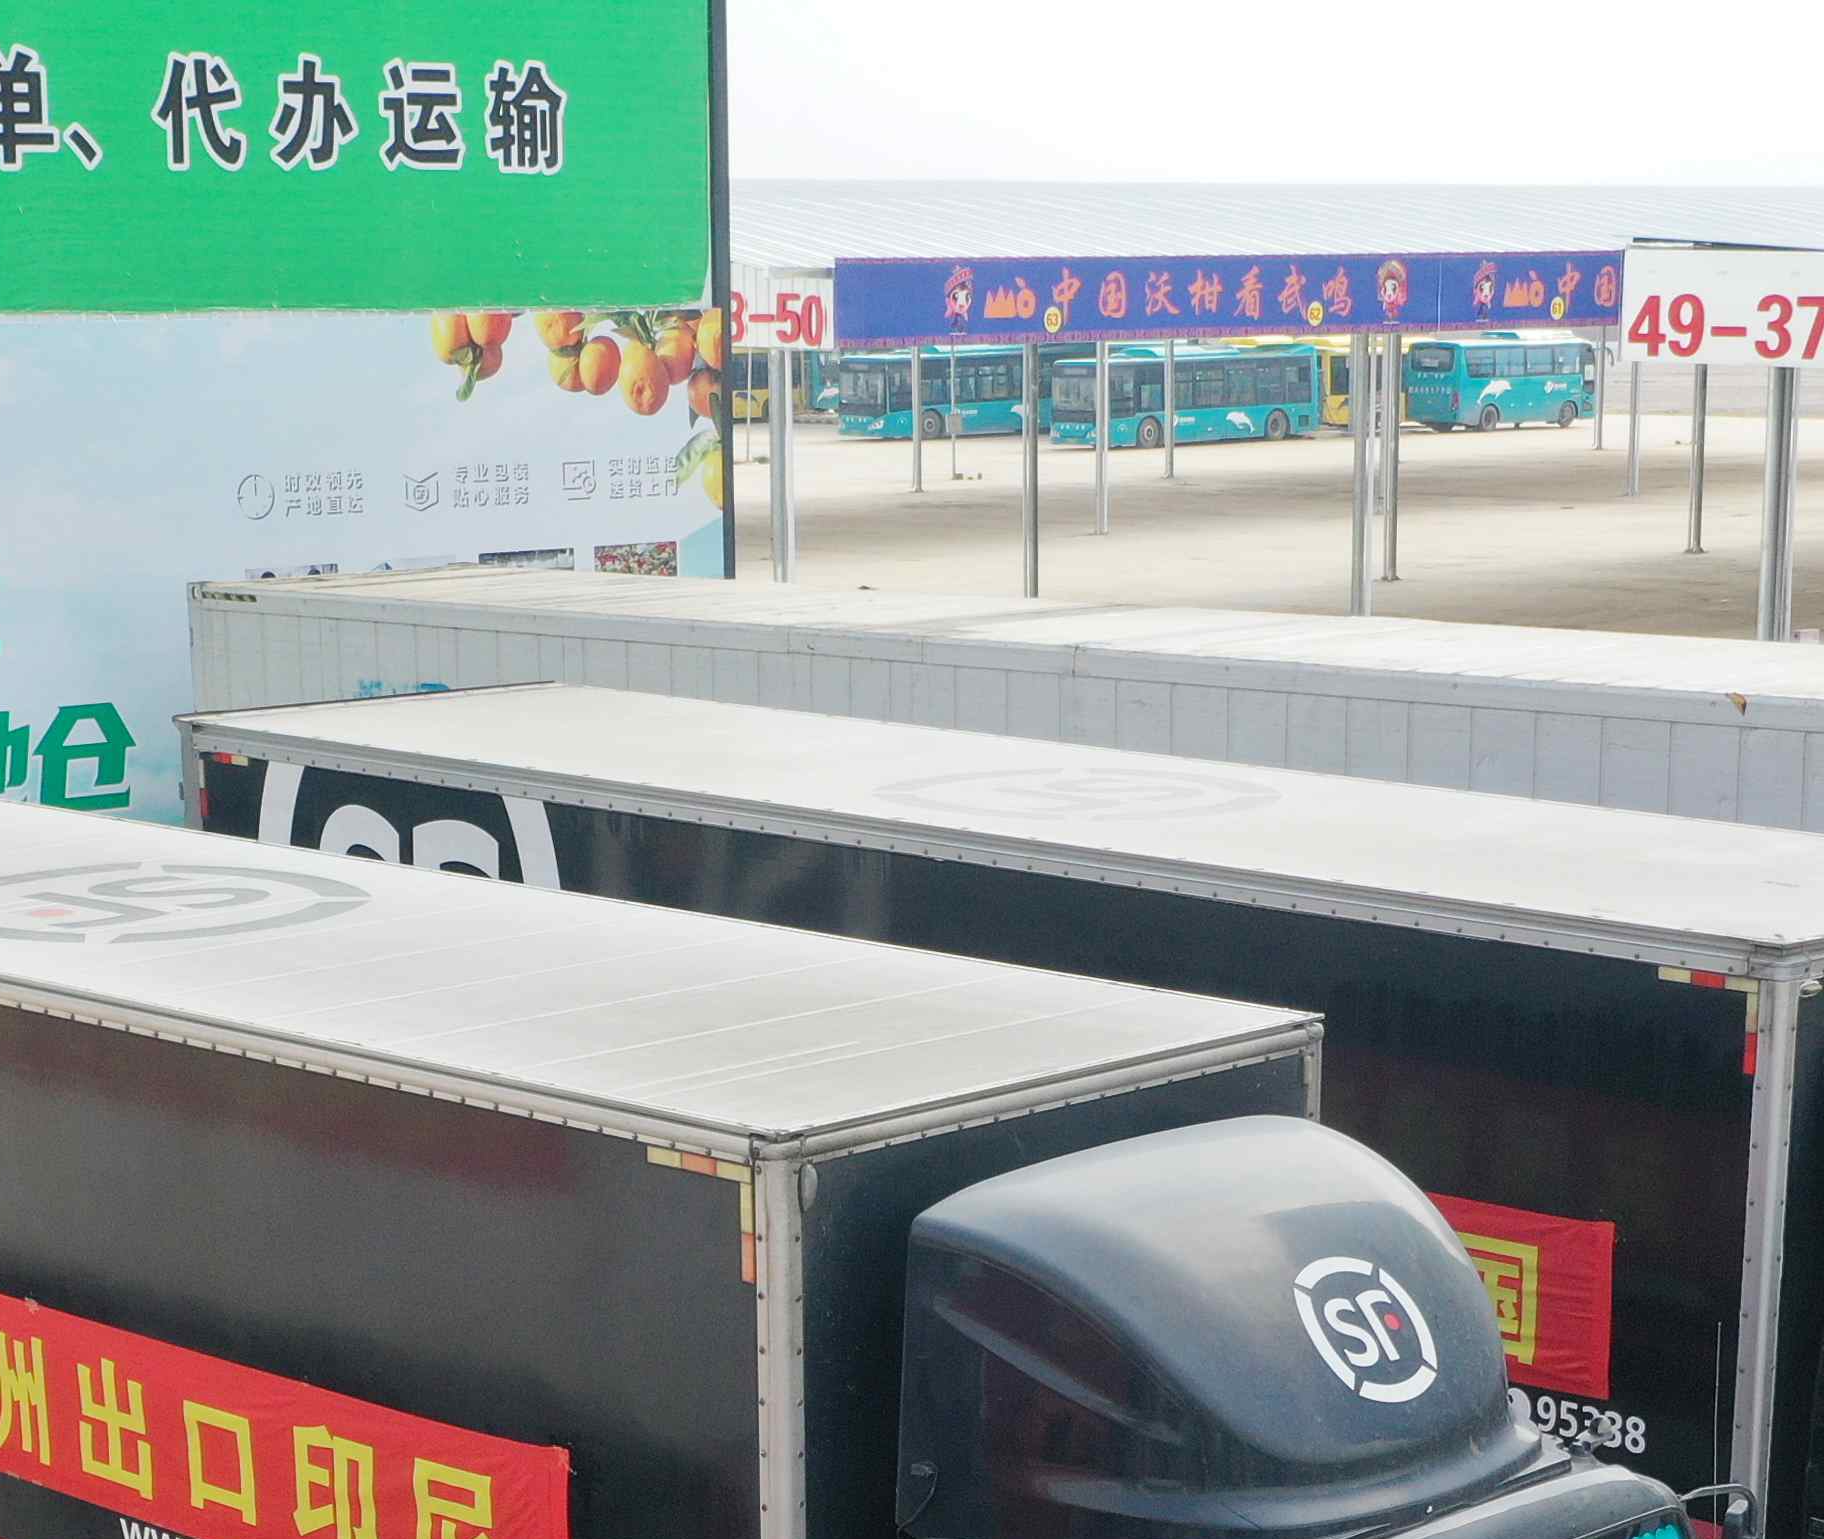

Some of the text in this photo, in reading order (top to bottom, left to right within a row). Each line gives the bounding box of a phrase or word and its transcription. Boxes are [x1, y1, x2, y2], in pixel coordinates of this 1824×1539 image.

[1052, 264, 1354, 321] 中国沃柑看武鸣
